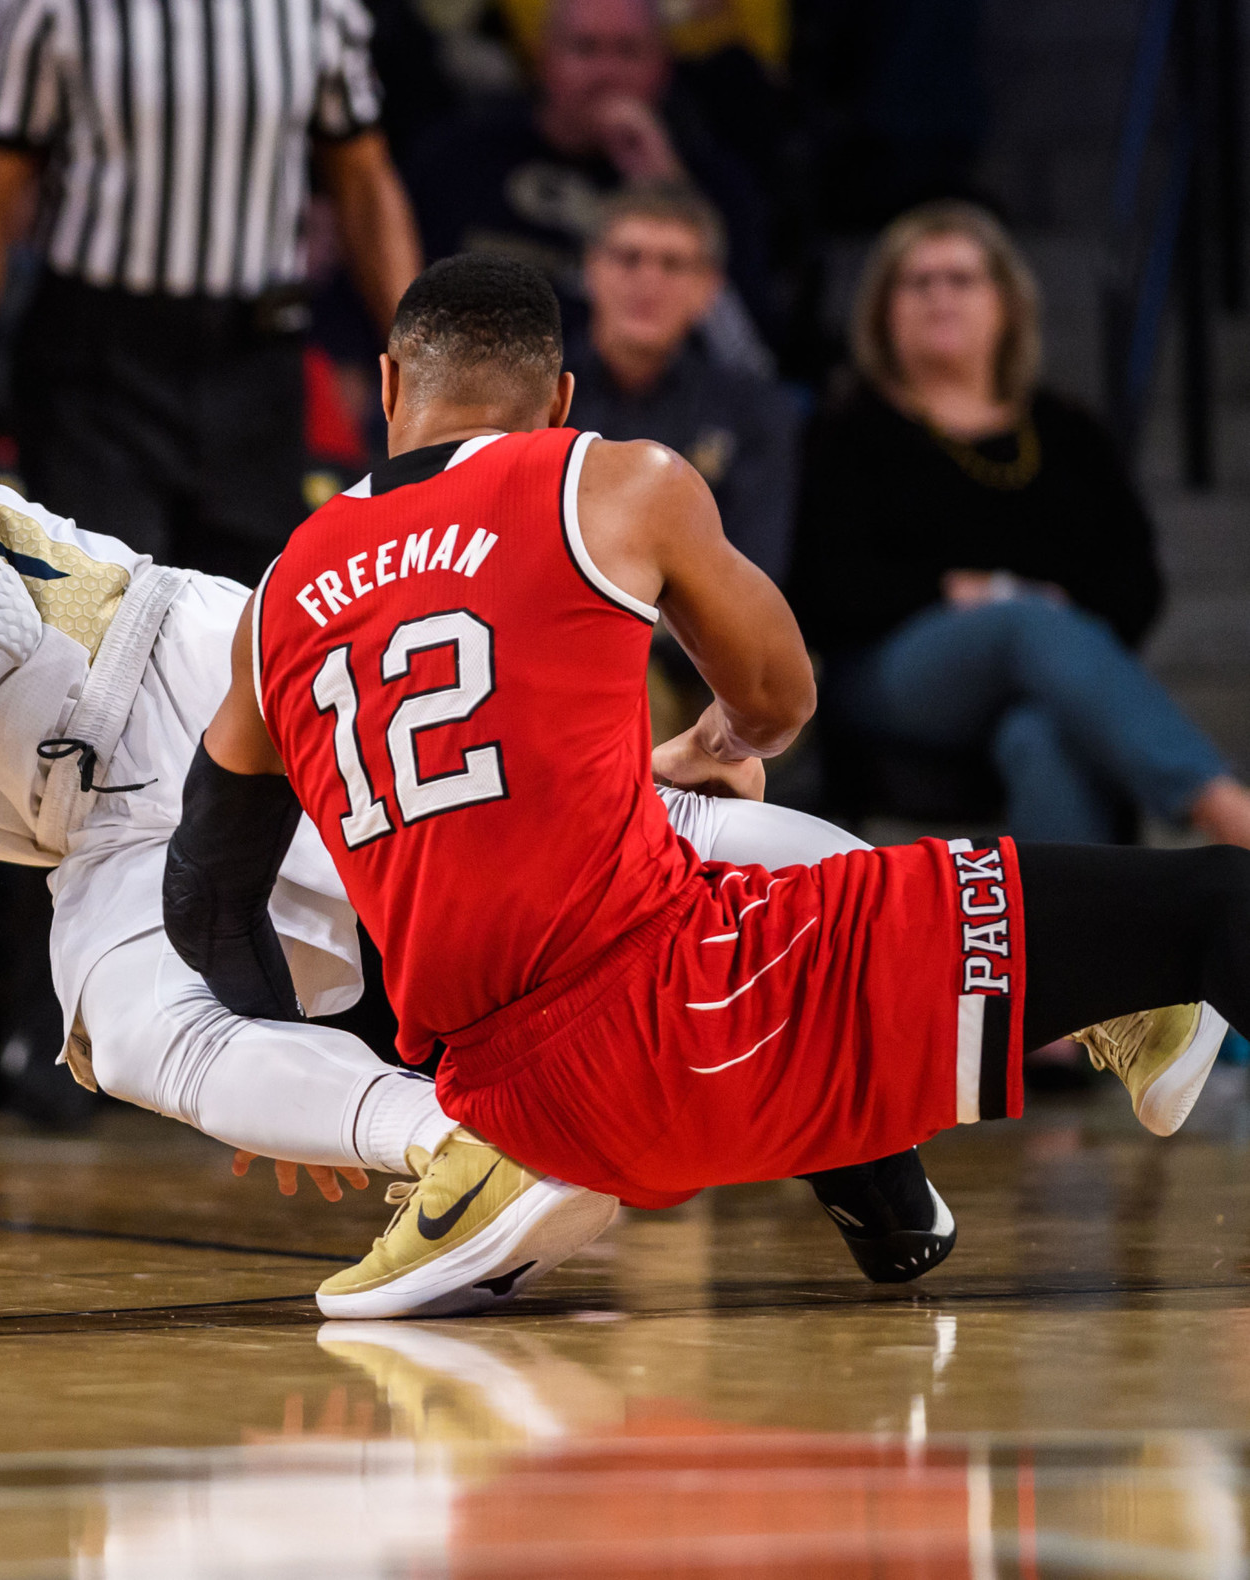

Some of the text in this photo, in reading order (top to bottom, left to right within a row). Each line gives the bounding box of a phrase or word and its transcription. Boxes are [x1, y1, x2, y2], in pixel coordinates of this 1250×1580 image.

[295, 524, 499, 628] FREEMAN
[311, 606, 510, 853] 12
[954, 848, 1010, 997] PACK
